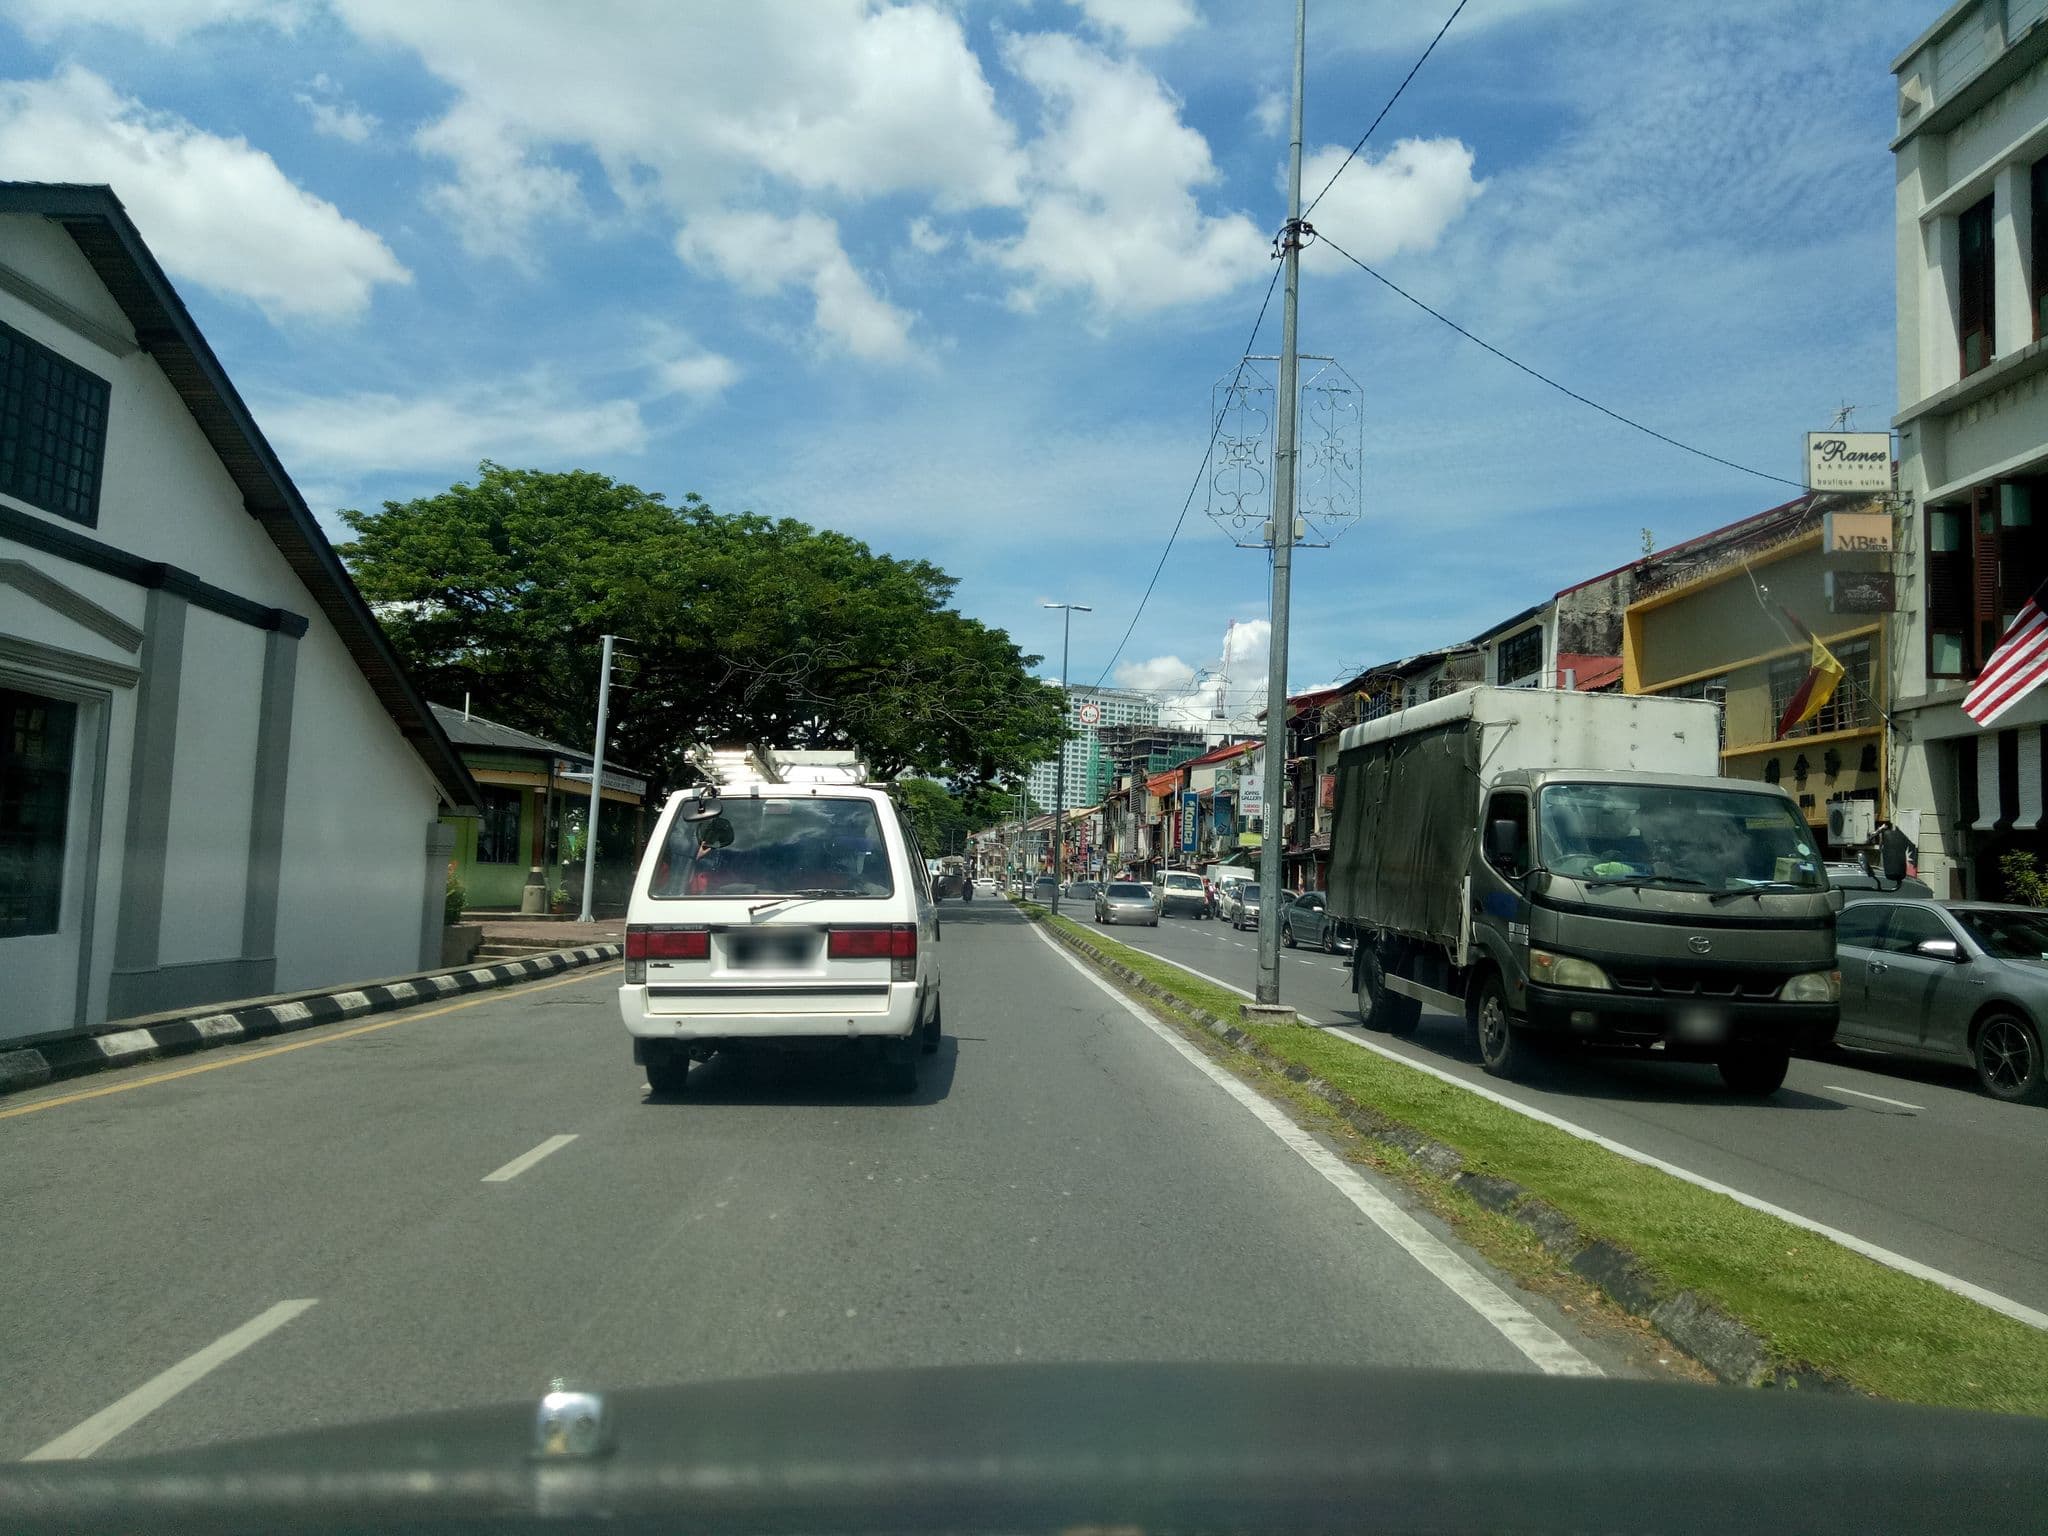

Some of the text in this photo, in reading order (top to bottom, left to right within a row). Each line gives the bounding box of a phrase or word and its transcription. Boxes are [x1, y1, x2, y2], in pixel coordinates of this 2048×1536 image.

[1822, 439, 1887, 462] Ranee
[1817, 463, 1883, 471] SARAWAK
[1817, 479, 1853, 487] boutique
[1184, 807, 1195, 844] Konica
